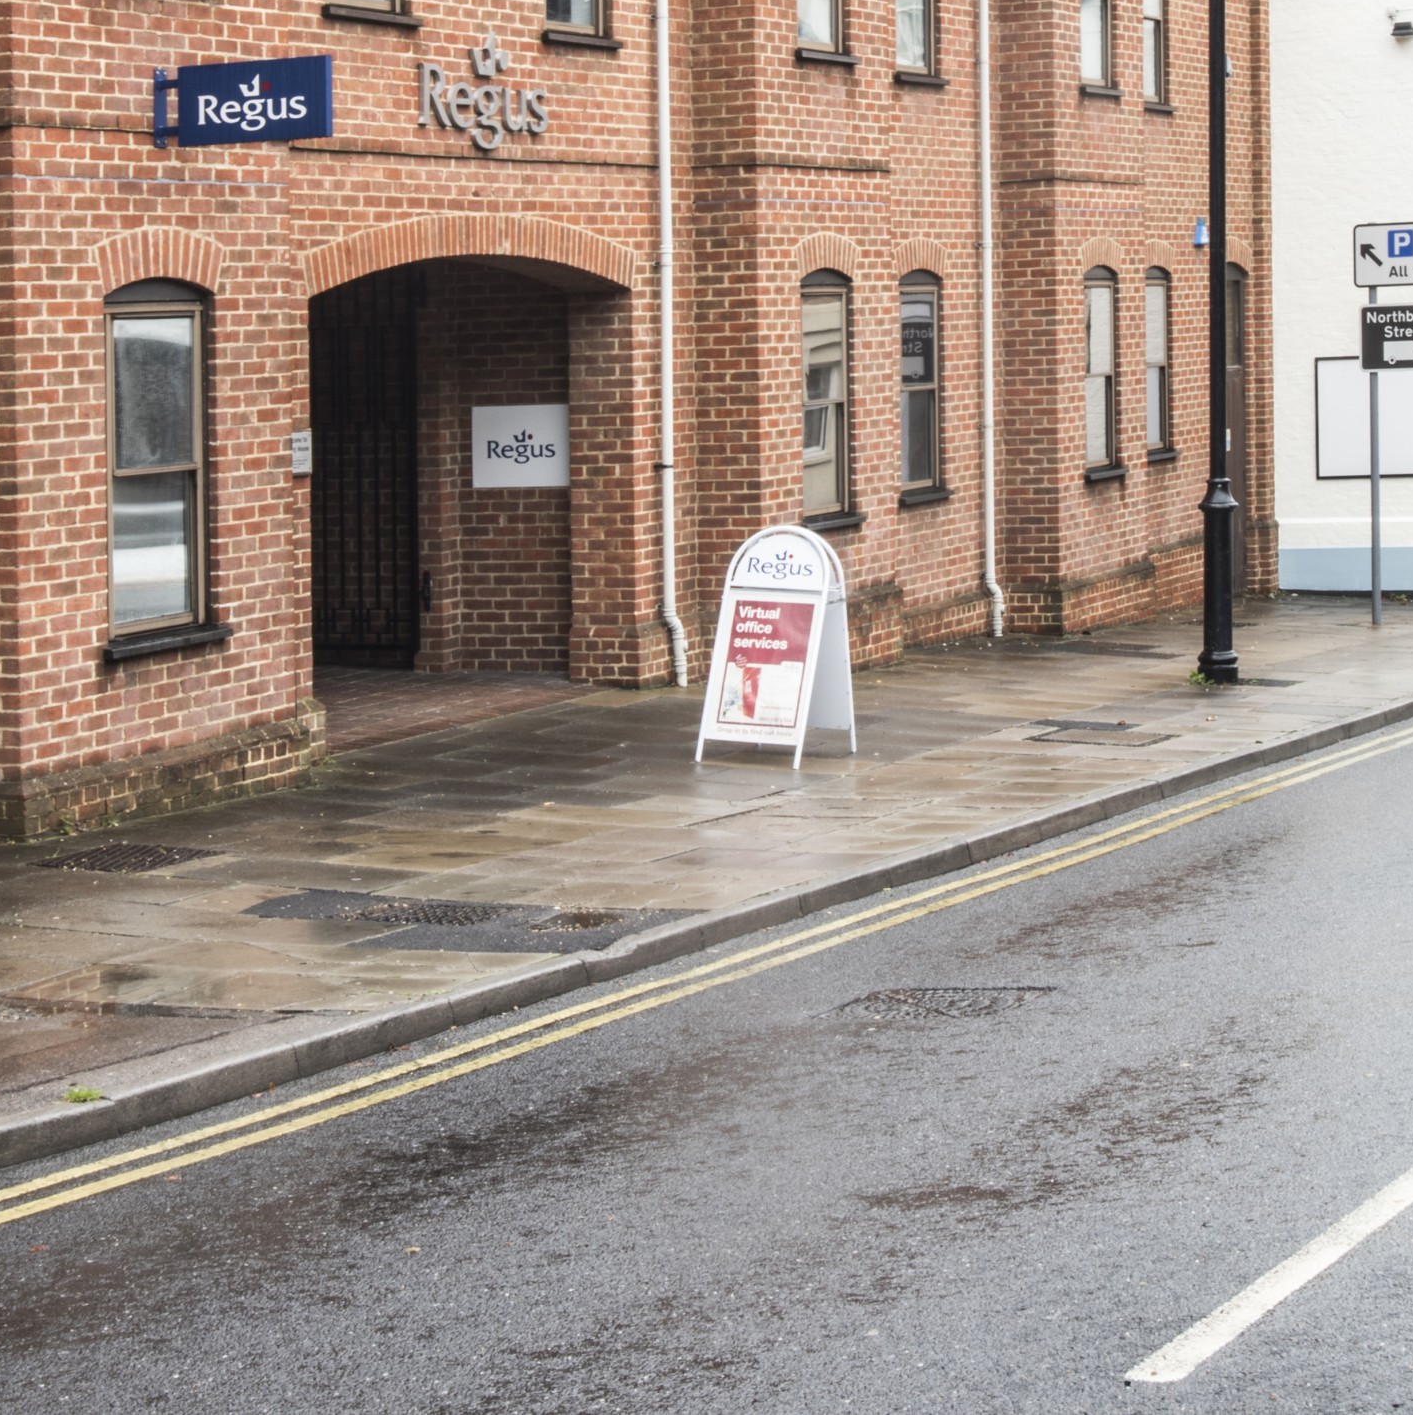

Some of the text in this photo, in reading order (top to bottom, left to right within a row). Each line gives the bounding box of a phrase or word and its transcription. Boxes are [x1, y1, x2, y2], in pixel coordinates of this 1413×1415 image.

[197, 95, 307, 131] Regus
[417, 62, 549, 150] Regus
[1389, 265, 1408, 278] All
[487, 440, 556, 464] Regus
[747, 557, 813, 580] Regus
[739, 606, 781, 620] Virtual
[736, 621, 773, 634] office
[733, 637, 788, 650] services
